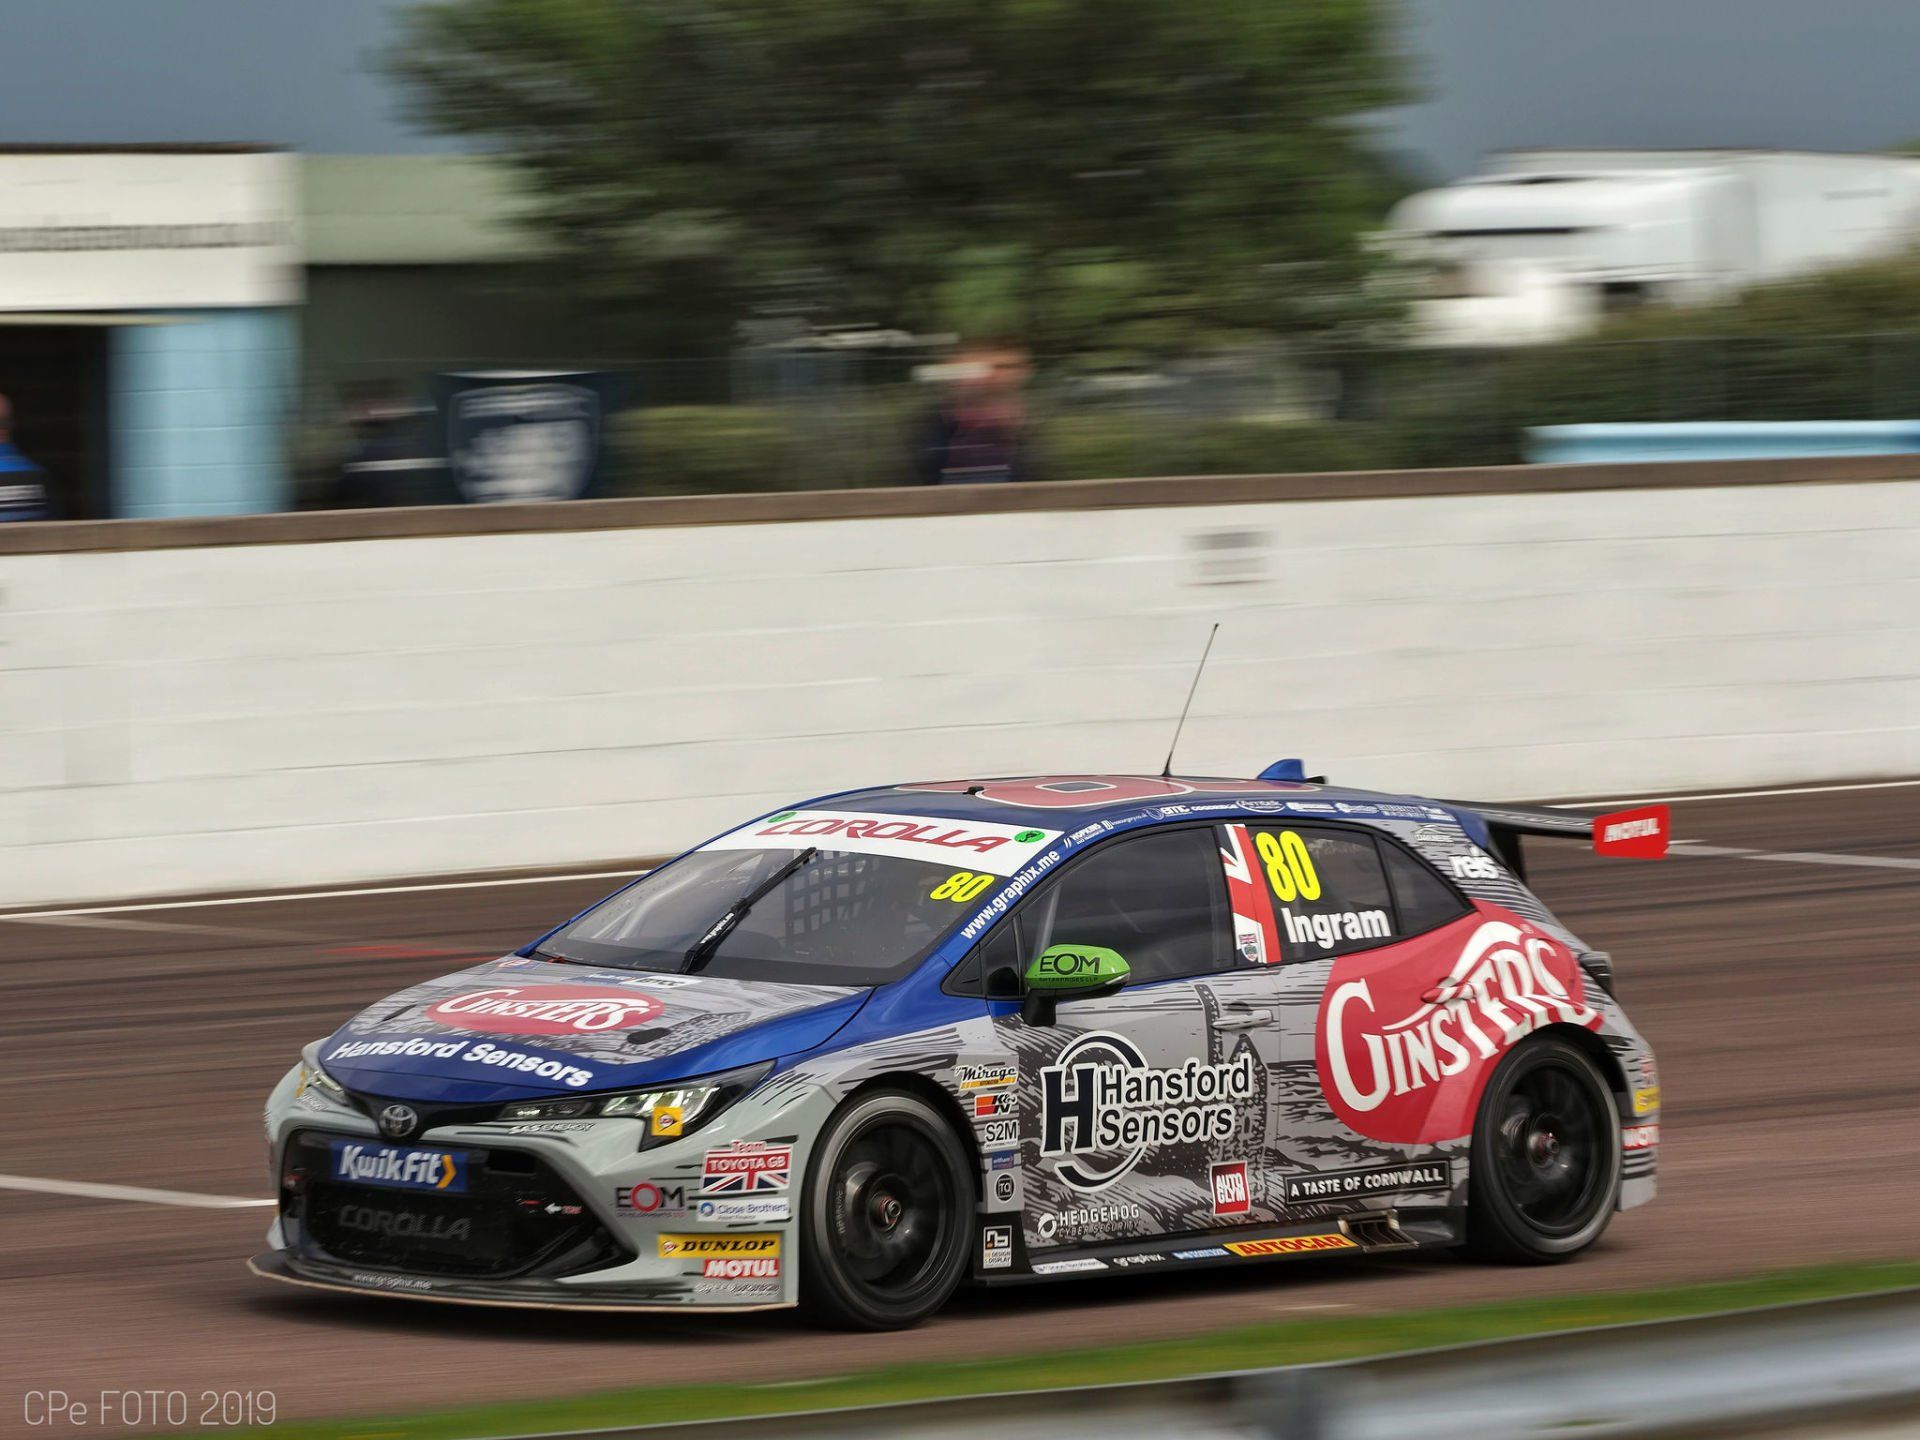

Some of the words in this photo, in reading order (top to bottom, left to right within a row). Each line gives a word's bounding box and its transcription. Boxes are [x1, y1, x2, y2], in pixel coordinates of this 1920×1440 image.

[755, 819, 1012, 853] COROLLA
[1255, 830, 1322, 903] 80
[930, 871, 996, 904] 80
[960, 850, 1061, 940] www.graphix.me
[1280, 906, 1392, 950] Ingram
[1040, 953, 1101, 976] EOM
[436, 989, 660, 1031] GINSTERS
[325, 1037, 464, 1061] Hansford
[463, 1043, 594, 1089] Sensors
[961, 1066, 1018, 1085] Mirage
[1100, 1055, 1251, 1107] Hansford
[985, 1121, 1018, 1142] S2M
[1100, 1106, 1234, 1147] Sensors
[731, 1140, 767, 1154] Team
[708, 1156, 766, 1172] TOYOTA
[767, 1156, 787, 1169] GB
[1216, 1172, 1243, 1189] AUTO
[1290, 1183, 1300, 1198] A
[1302, 1179, 1341, 1196] TASTE
[1343, 1176, 1361, 1192] OF
[1364, 1167, 1444, 1189] CORNWALL
[614, 1183, 684, 1212] EOM
[1218, 1184, 1246, 1204] GLYM
[338, 1204, 472, 1241] COROLLA
[1058, 1203, 1140, 1227] HEDGEHOG
[1057, 1225, 1091, 1238] CYBER
[681, 1239, 776, 1252] DUNLOP
[1238, 1235, 1349, 1257] AUTOCAR
[704, 1259, 779, 1277] MOTUL
